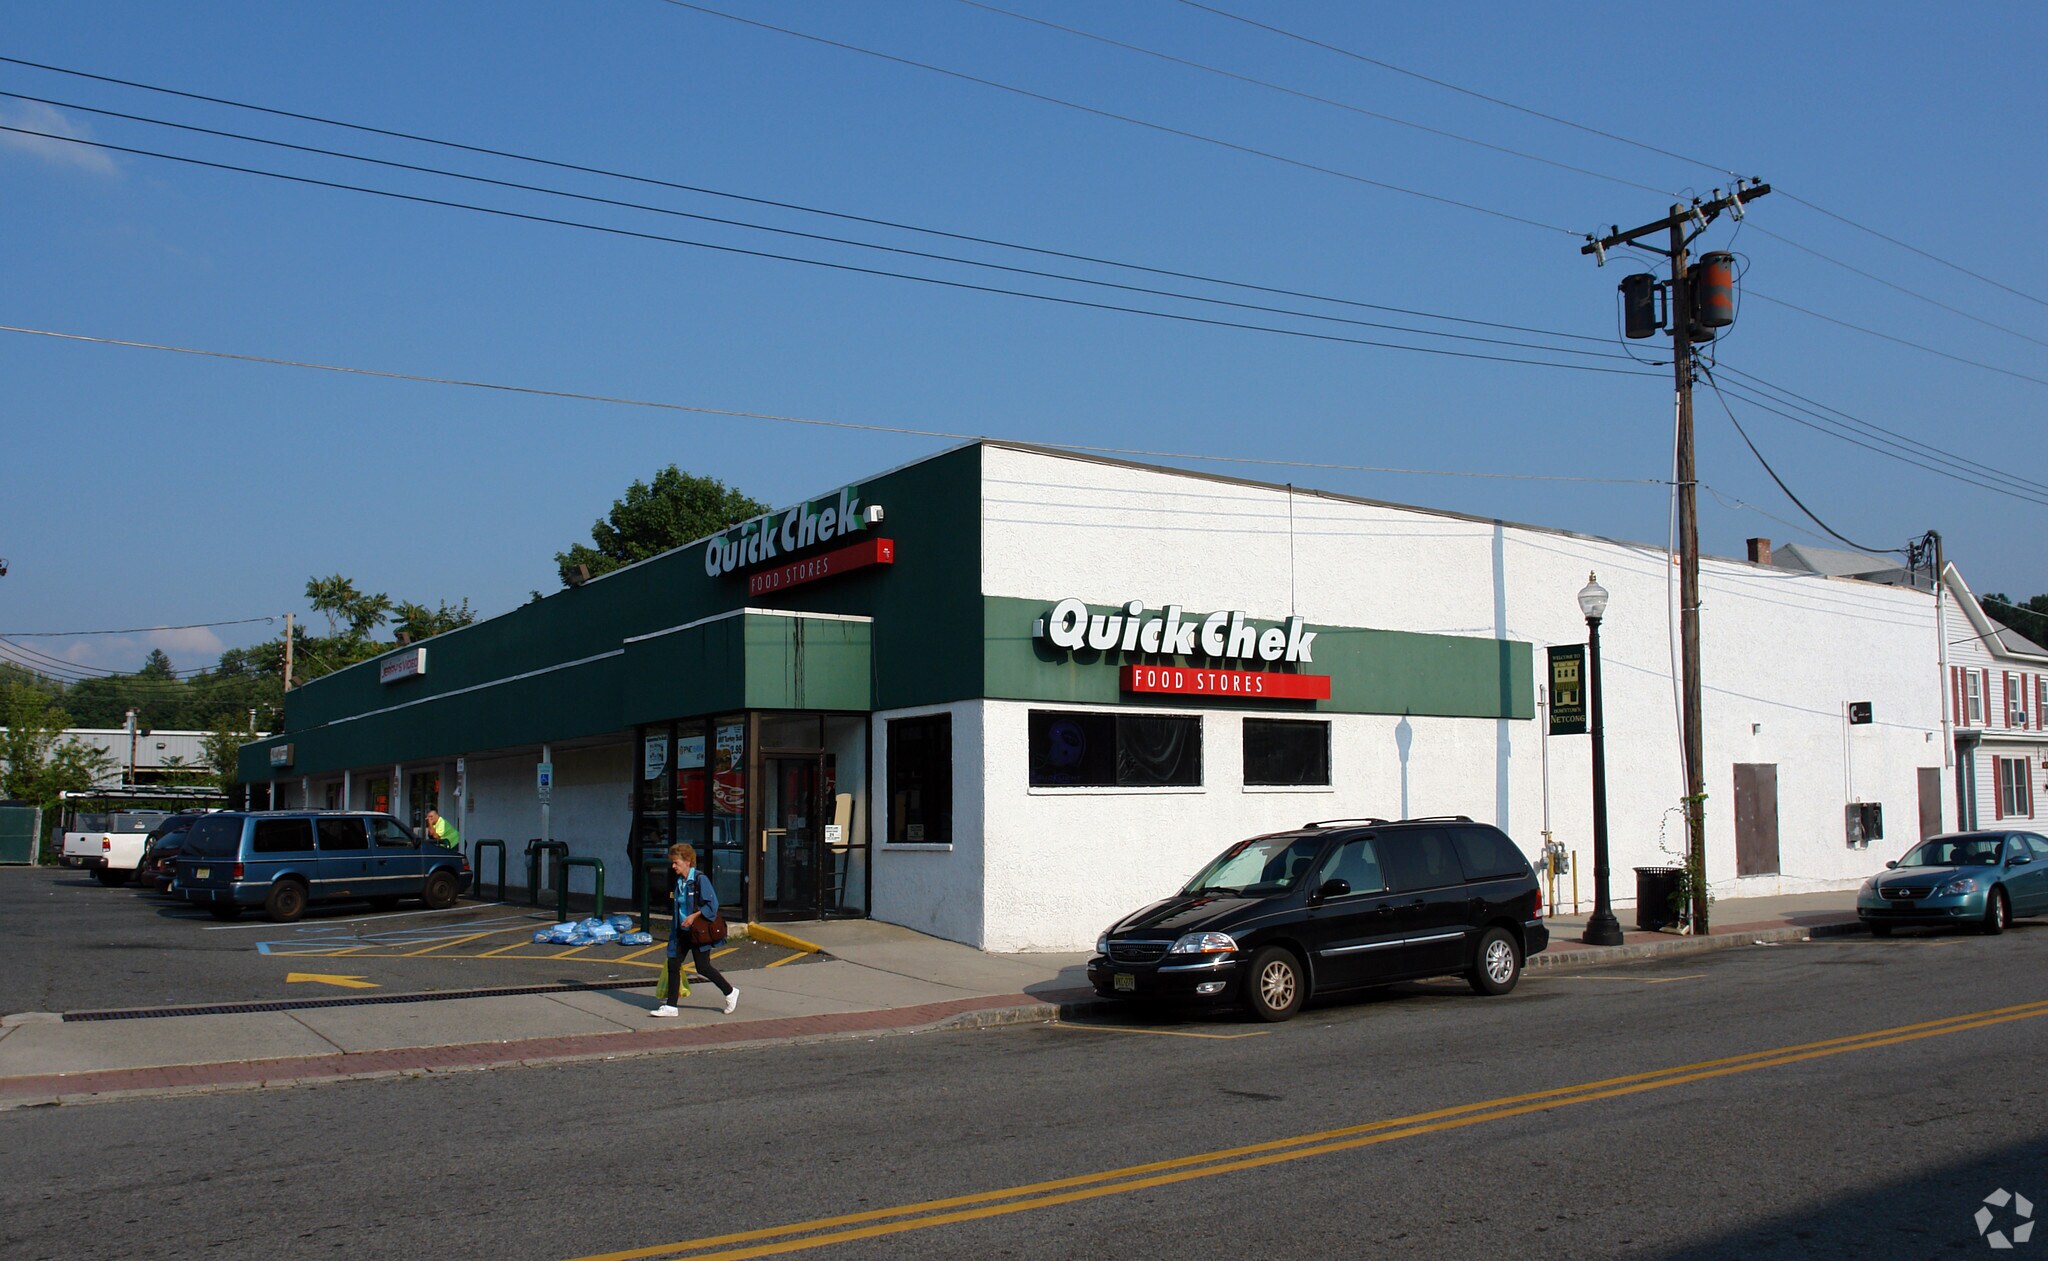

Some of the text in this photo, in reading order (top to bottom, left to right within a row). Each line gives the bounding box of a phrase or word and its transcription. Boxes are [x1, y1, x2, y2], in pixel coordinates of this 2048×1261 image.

[751, 557, 829, 592] FOOD STORES
[1135, 669, 1263, 692] FOOD STORES
[1551, 715, 1586, 724] NETCONG
